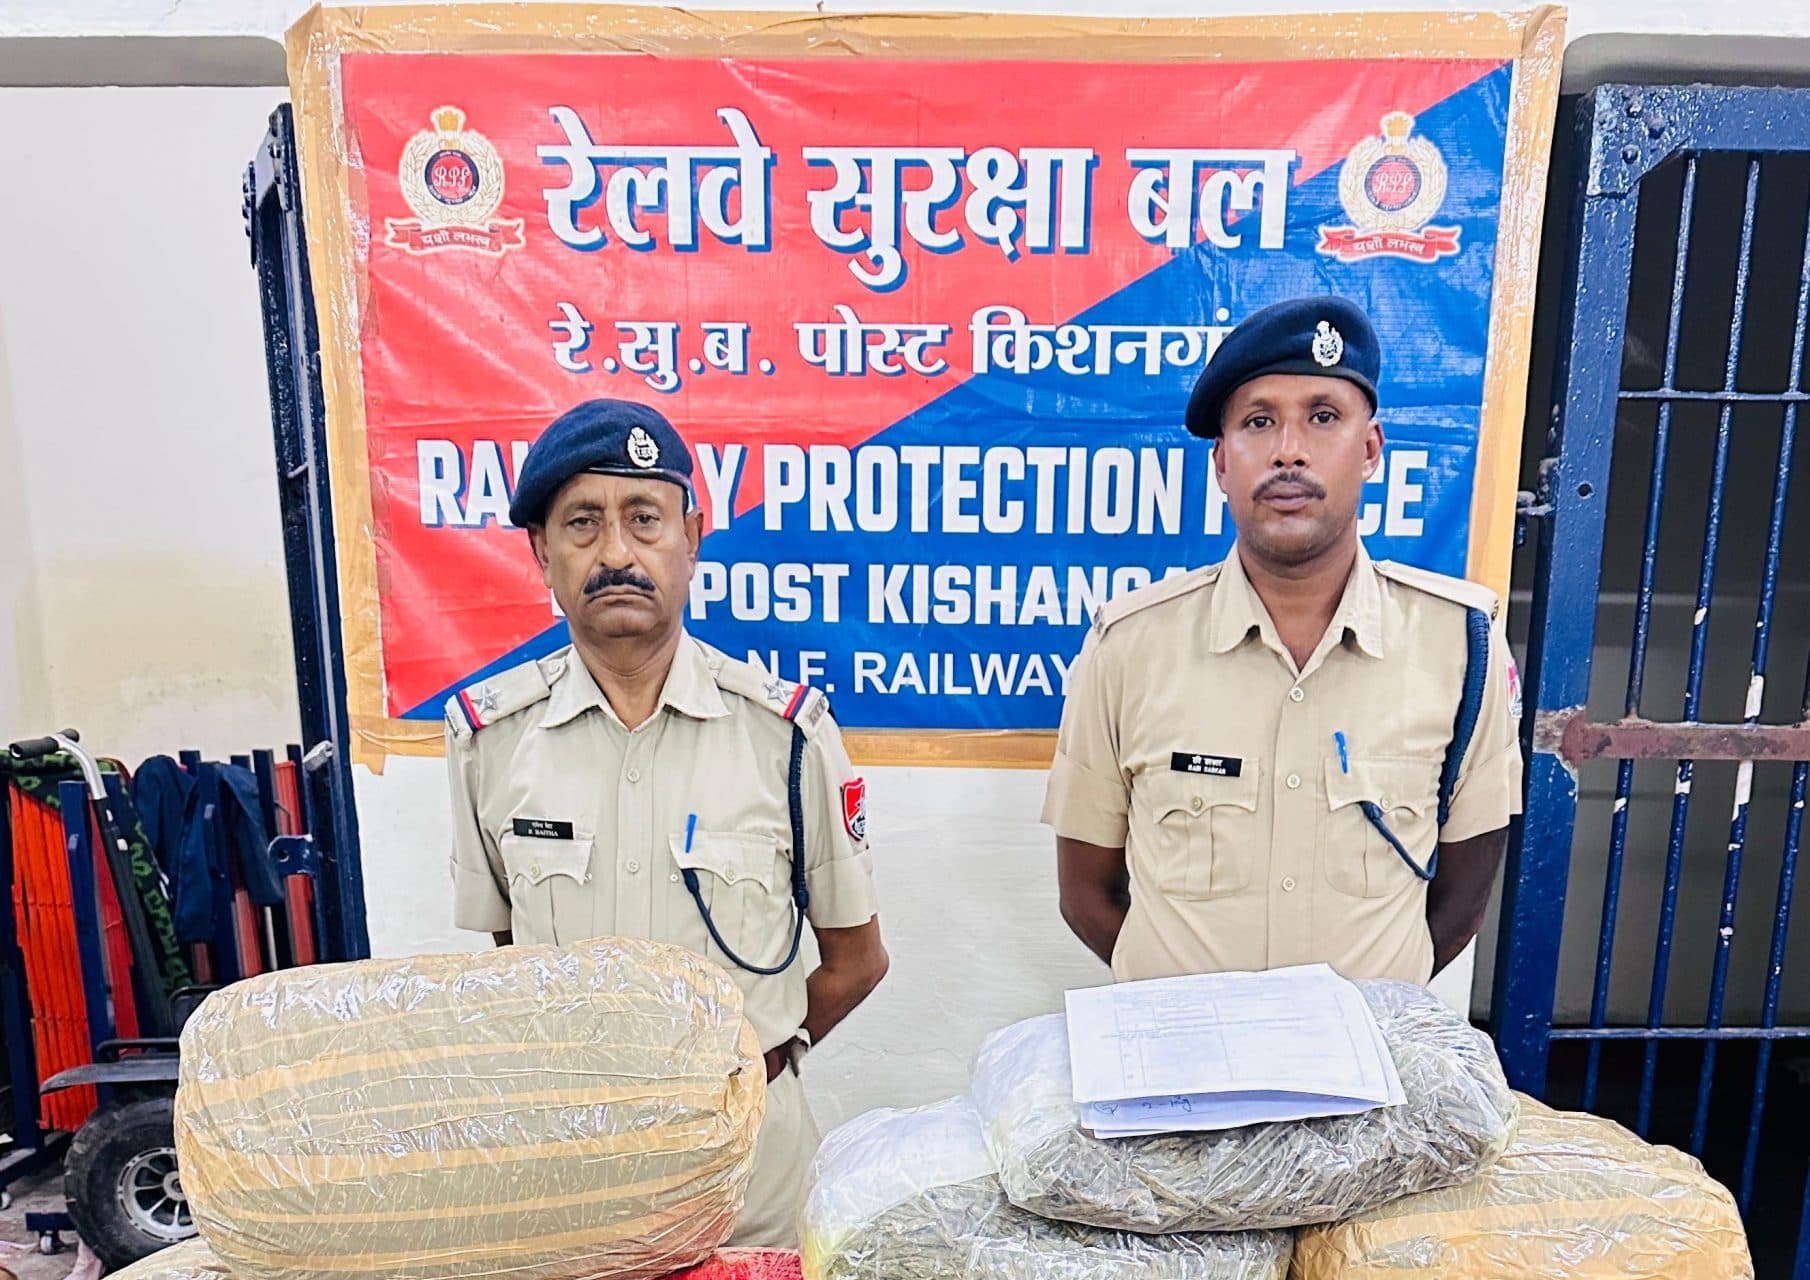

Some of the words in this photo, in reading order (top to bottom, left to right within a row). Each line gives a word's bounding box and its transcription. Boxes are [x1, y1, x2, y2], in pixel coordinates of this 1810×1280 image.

[537, 107, 770, 248] रेलवे
[803, 147, 1093, 286] सुरक्षा
[1126, 148, 1296, 249] बल
[794, 305, 949, 373] पोस्ट
[968, 305, 1233, 375] किशनगं
[764, 445, 1184, 534] PROTECTION
[1204, 449, 1428, 537] FCE
[689, 561, 849, 622] POST
[868, 564, 1187, 625] KISHAN
[854, 651, 1080, 696] RAILWAY
